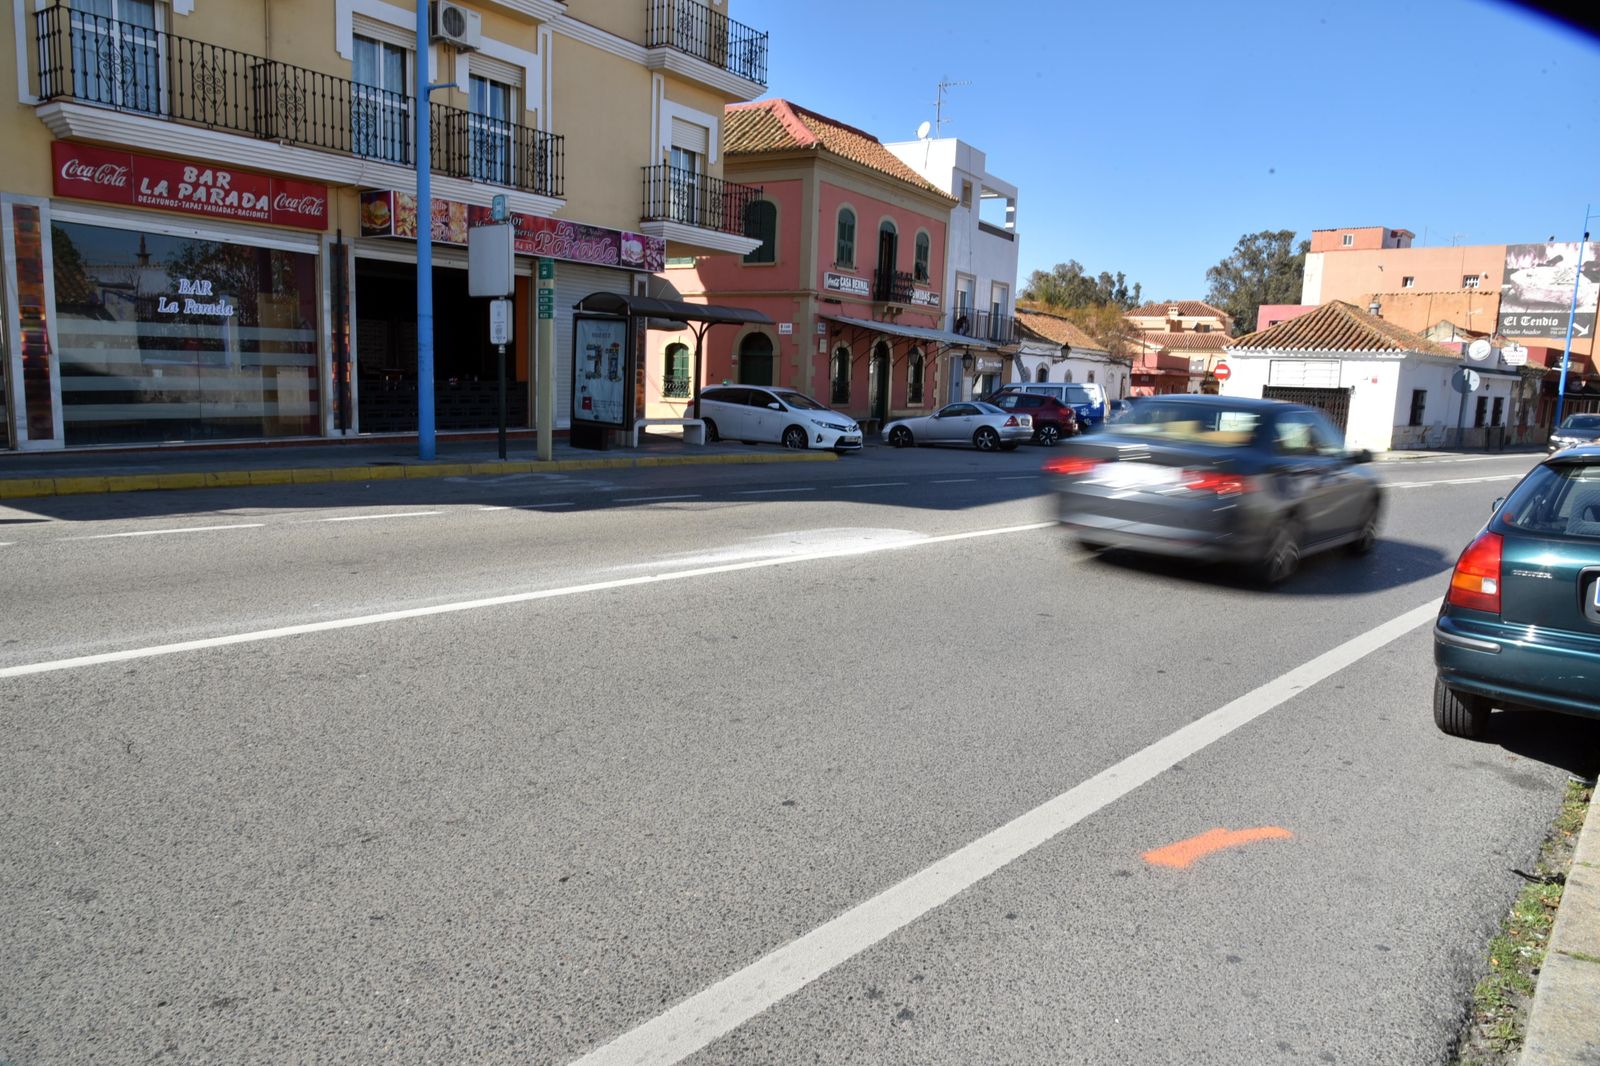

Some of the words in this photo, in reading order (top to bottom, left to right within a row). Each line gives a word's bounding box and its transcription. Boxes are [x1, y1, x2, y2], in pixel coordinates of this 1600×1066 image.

[61, 159, 128, 187] Coca-Cola
[183, 166, 231, 189] BAR
[140, 178, 168, 197] LA
[178, 183, 269, 211] PARADA
[273, 193, 323, 216] Coca-Cola
[535, 230, 618, 265] Parada
[178, 278, 213, 296] BAR
[840, 277, 852, 288] CASA
[158, 296, 179, 313] La
[183, 298, 233, 316] Parada
[1504, 316, 1516, 326] El
